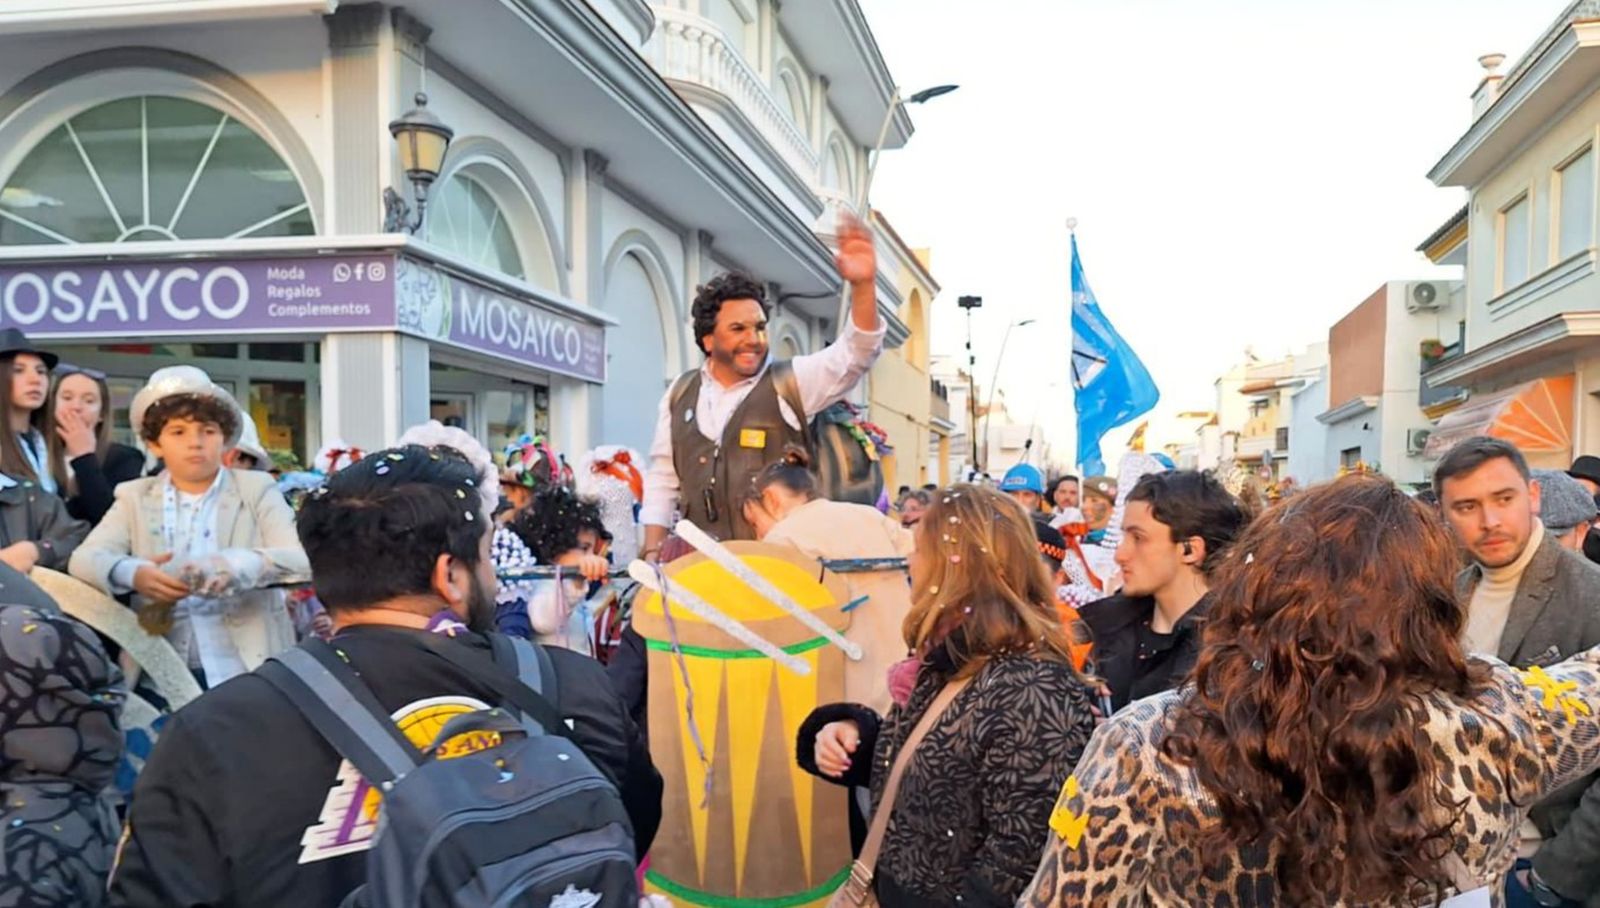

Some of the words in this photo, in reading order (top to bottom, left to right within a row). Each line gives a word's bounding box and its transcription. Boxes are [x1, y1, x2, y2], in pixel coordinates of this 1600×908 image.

[267, 266, 305, 280] Moda
[0, 266, 249, 325] OSAYCO
[267, 284, 322, 300] Regalos
[268, 302, 371, 317] Complementos
[460, 288, 581, 366] MOSAYCO
